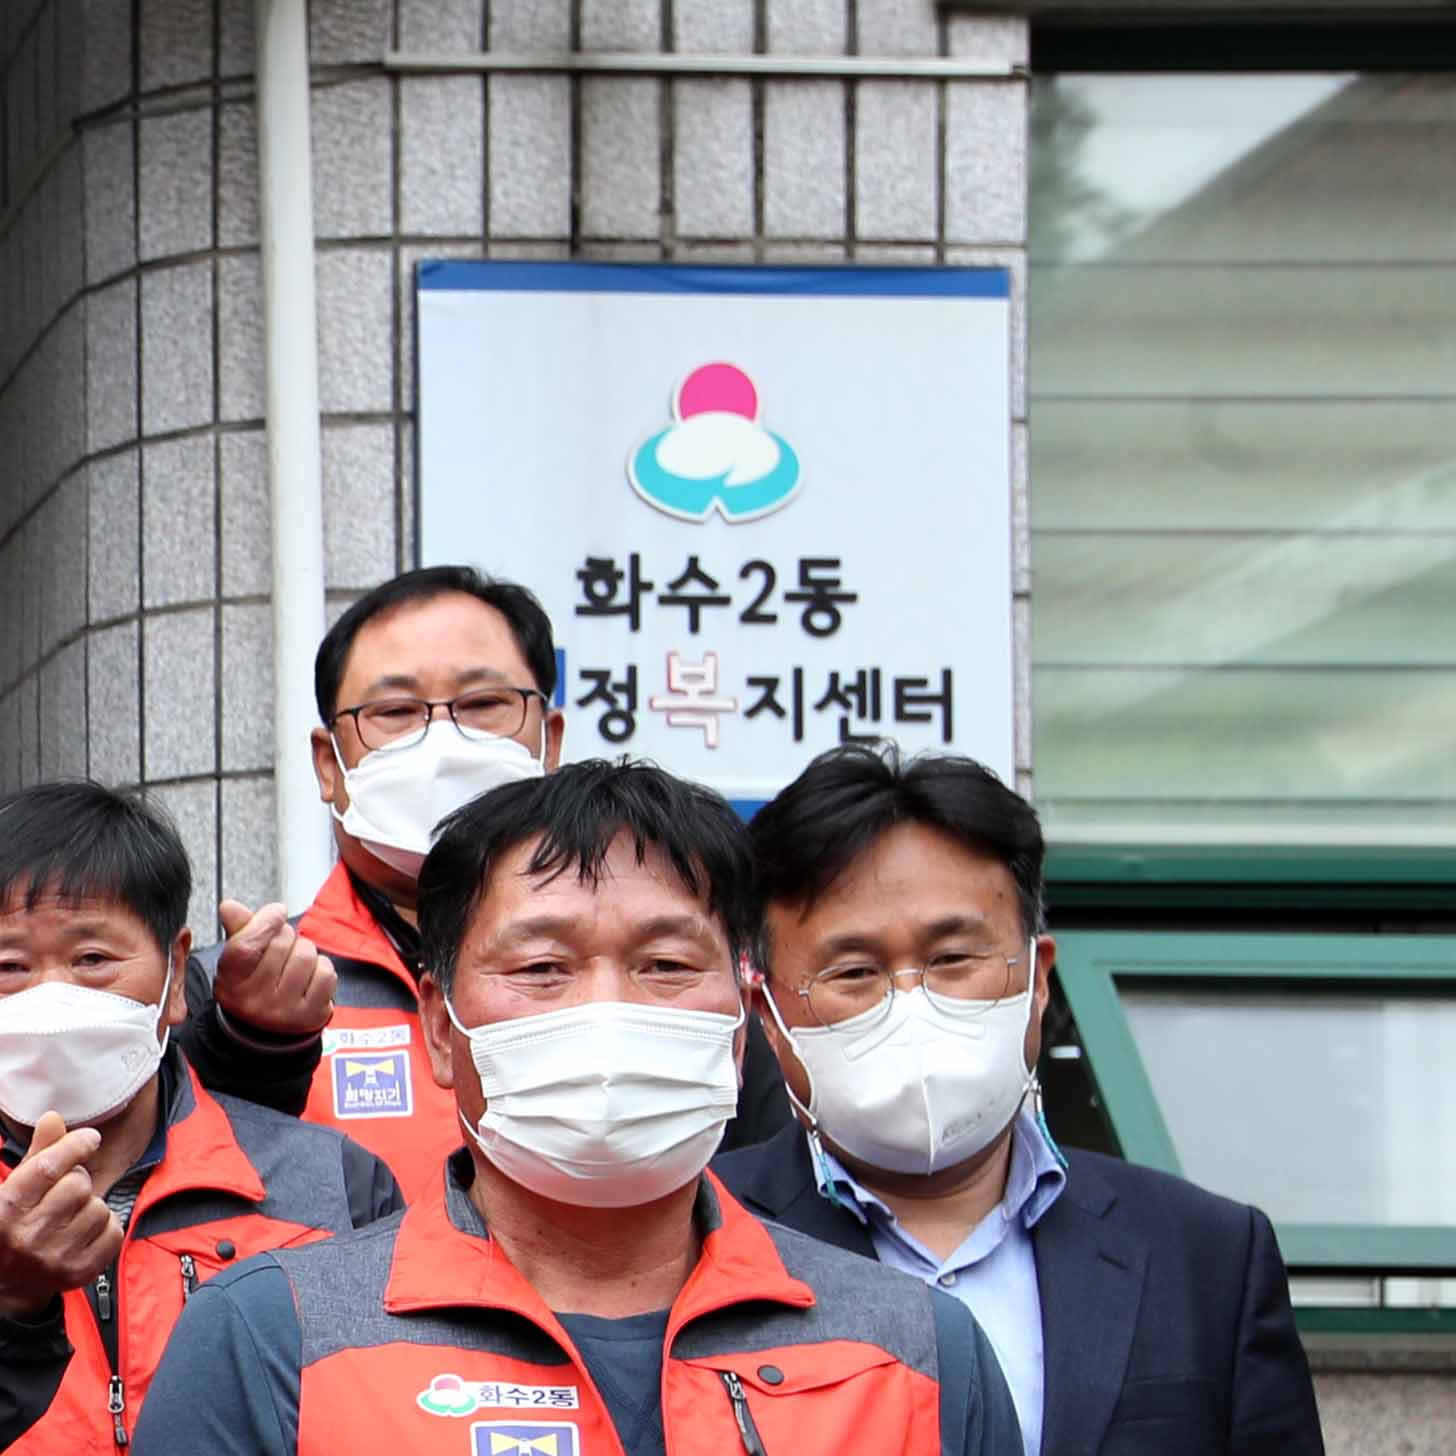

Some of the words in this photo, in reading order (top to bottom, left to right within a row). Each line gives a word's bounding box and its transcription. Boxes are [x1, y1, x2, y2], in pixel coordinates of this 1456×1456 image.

[574, 552, 858, 637] 화수2동
[554, 647, 955, 749] 정복지센터
[478, 1383, 577, 1409] 화수2동
